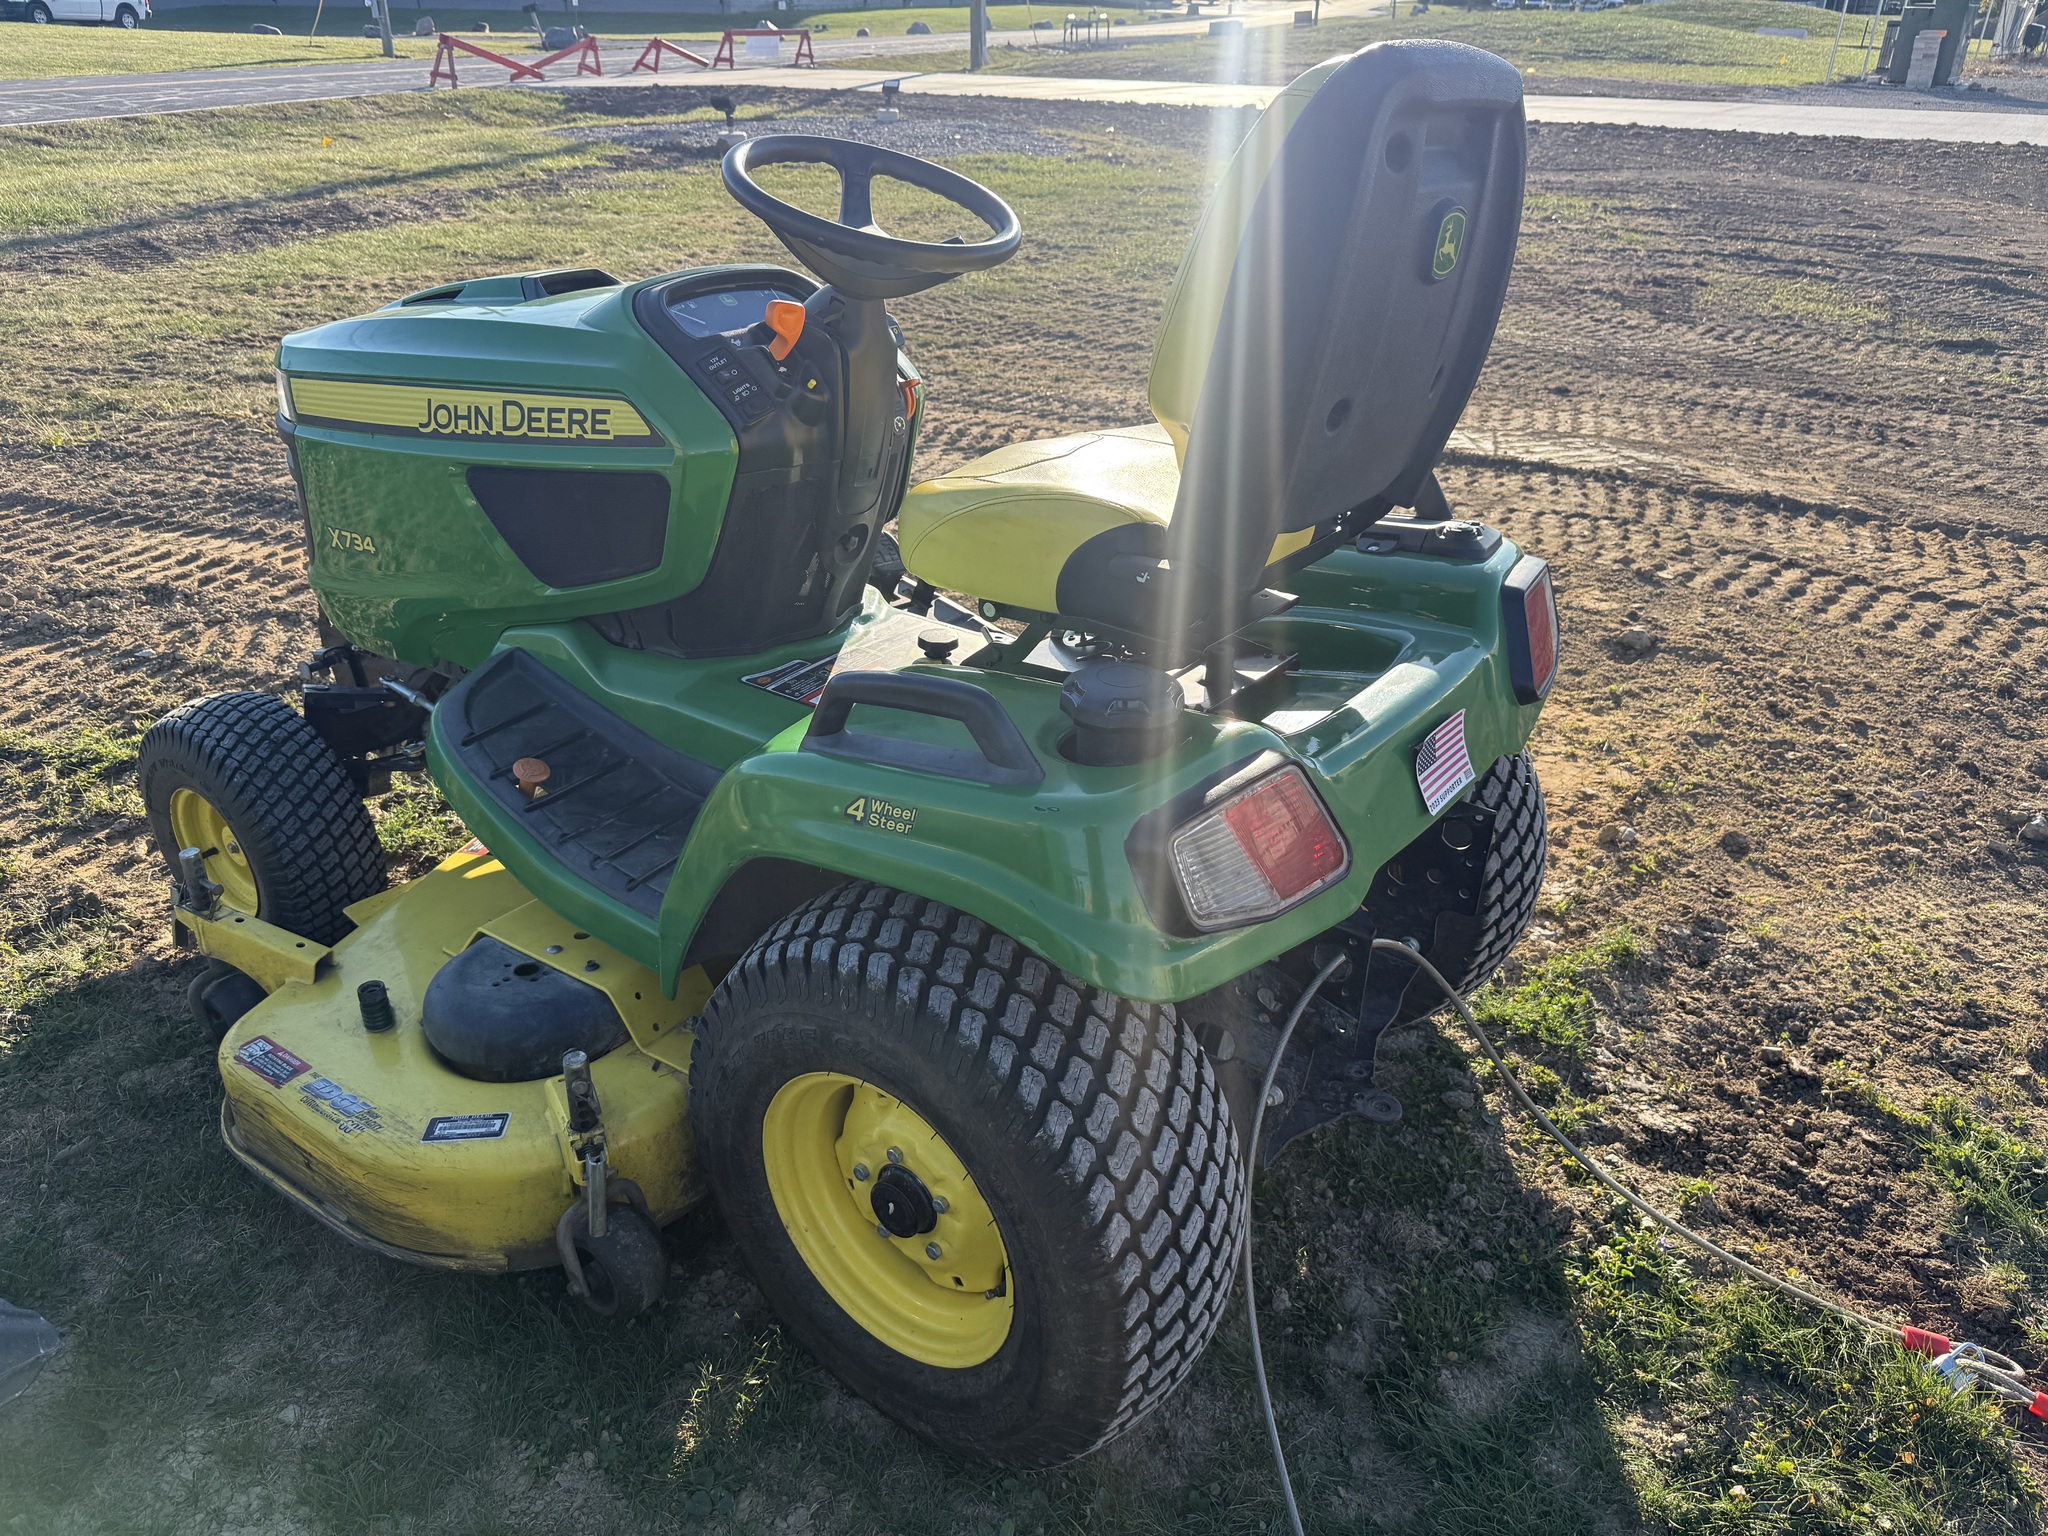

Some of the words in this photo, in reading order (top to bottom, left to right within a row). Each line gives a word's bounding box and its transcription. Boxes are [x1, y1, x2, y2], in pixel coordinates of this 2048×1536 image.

[708, 358, 728, 371] OUTLET
[732, 383, 751, 395] LIGHTS
[419, 398, 494, 432] JOHN
[502, 400, 612, 436] DEERE
[327, 526, 377, 555] X734
[1440, 777, 1463, 803] SUPPORTER
[846, 798, 866, 822] 4
[871, 798, 917, 822] Wheel
[868, 813, 912, 834] Steer
[282, 1052, 302, 1066] DANGER
[300, 1078, 374, 1117] EDGE
